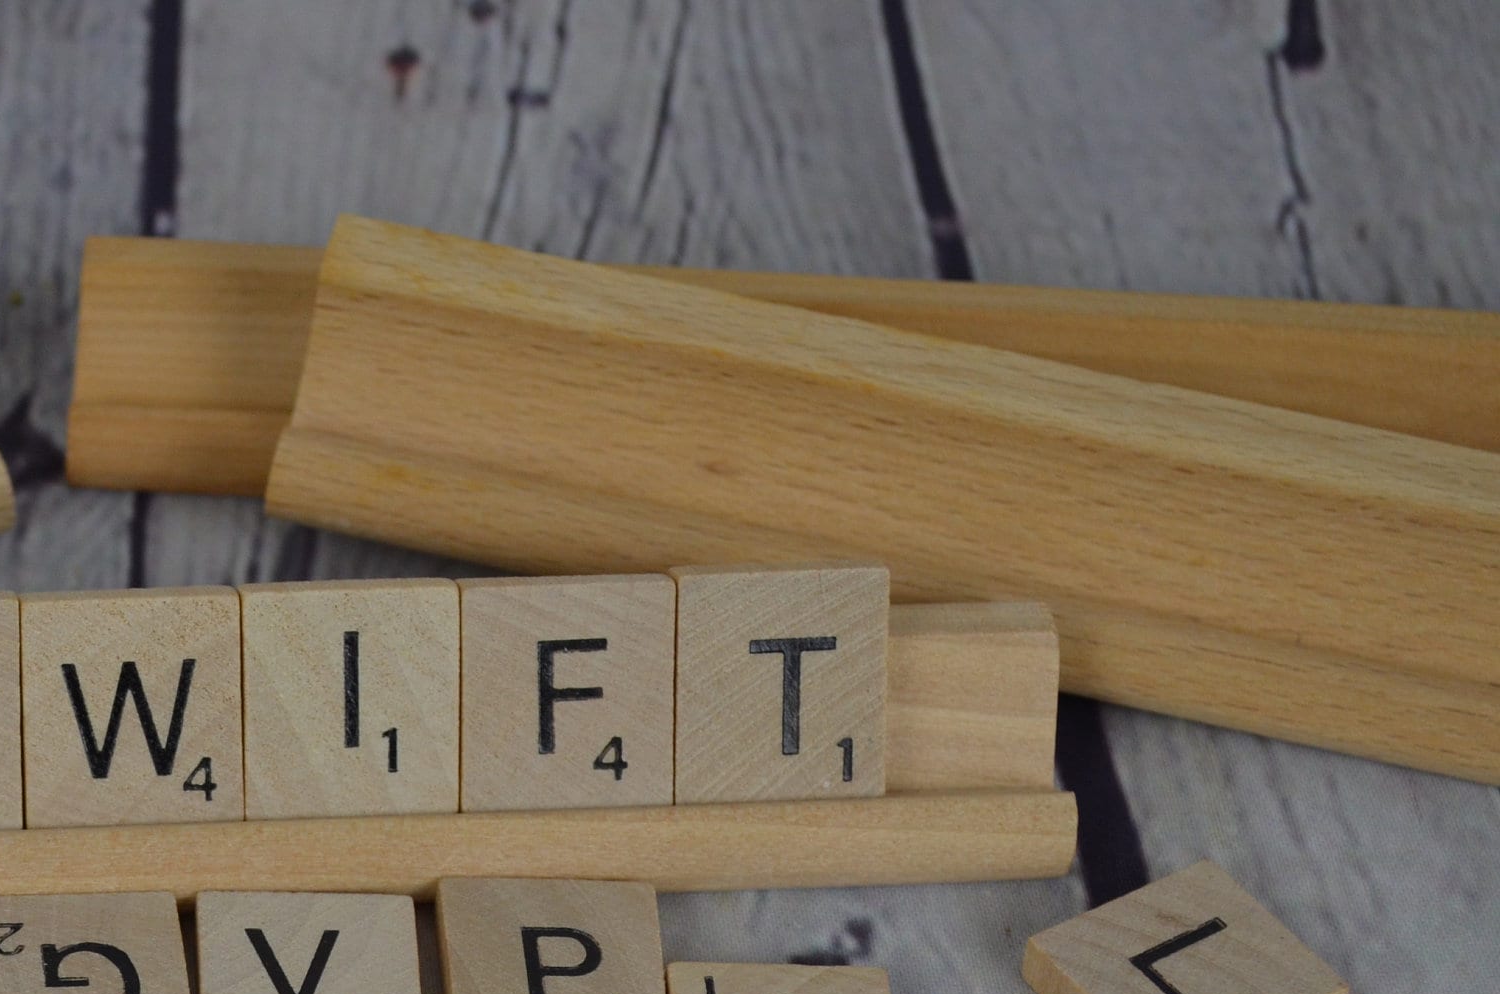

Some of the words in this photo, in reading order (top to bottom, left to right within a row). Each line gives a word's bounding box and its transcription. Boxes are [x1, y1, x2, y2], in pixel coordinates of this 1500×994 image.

[183, 757, 217, 801] 4
[382, 728, 398, 773] 1
[593, 736, 628, 780] 4
[837, 737, 853, 782] 1
